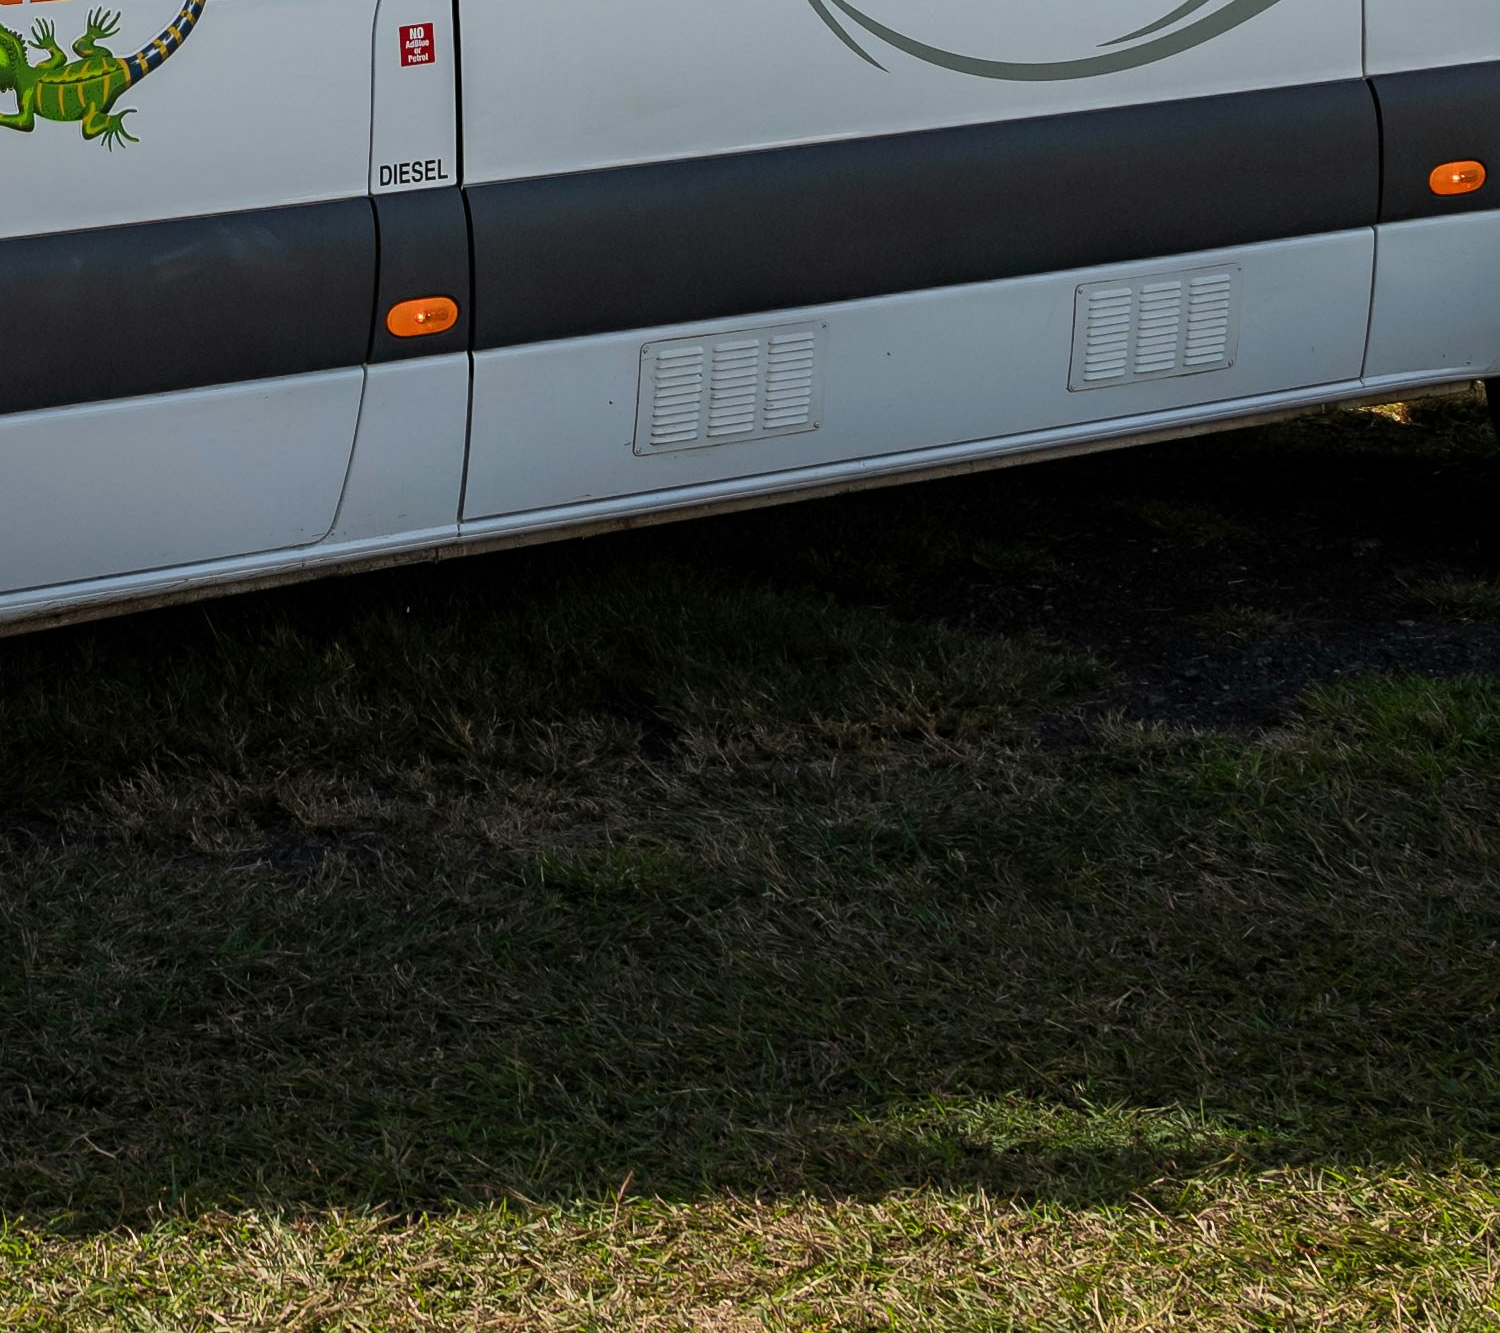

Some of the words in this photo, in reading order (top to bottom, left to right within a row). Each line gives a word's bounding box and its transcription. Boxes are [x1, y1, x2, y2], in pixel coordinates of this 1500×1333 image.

[409, 26, 425, 40] NO
[413, 47, 422, 55] or
[407, 52, 429, 64] Petrol
[379, 159, 449, 187] DIESEL
